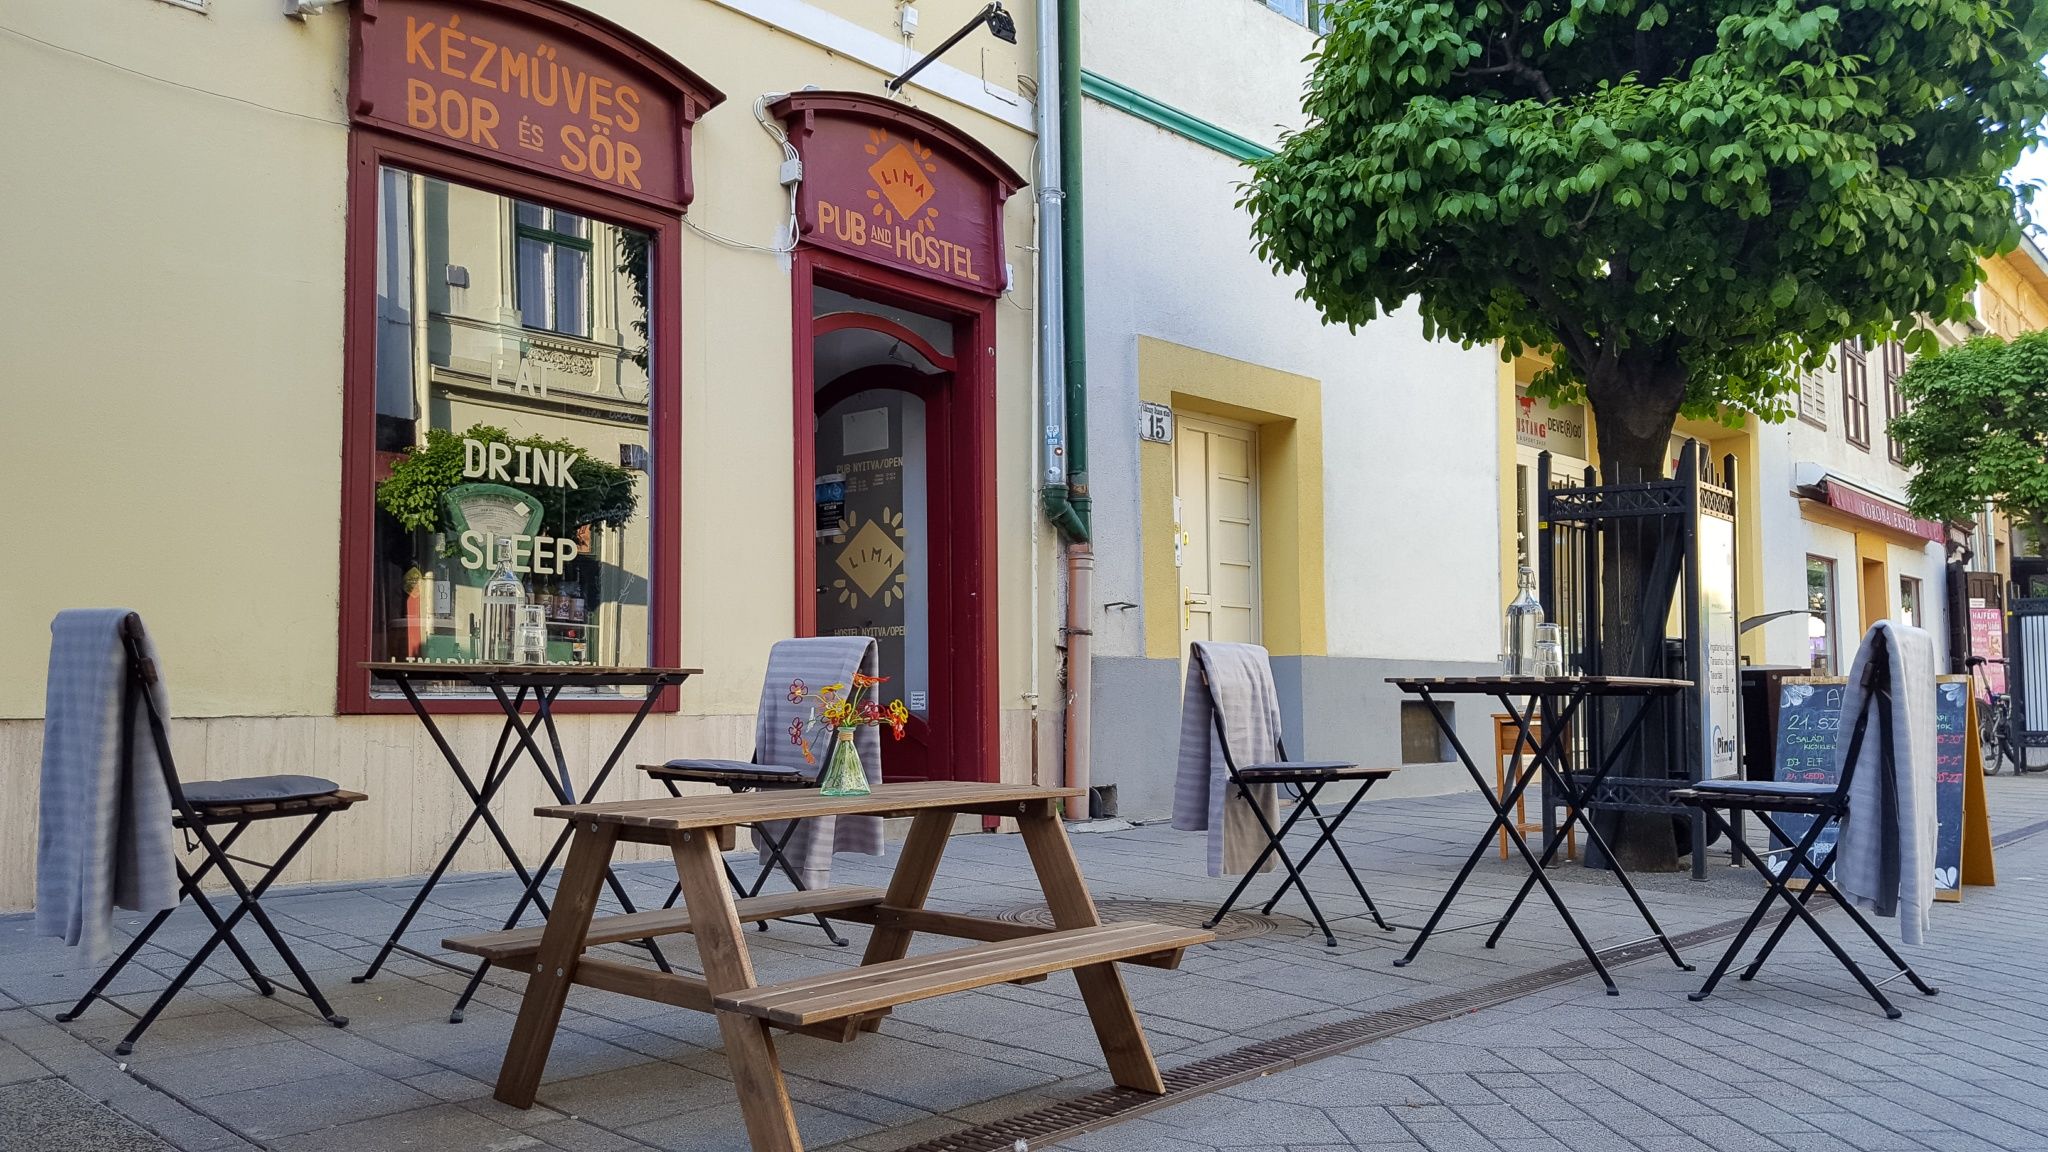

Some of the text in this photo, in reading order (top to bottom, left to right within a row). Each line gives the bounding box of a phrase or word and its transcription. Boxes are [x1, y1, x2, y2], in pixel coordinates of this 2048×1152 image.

[406, 14, 640, 133] KÉZMŰVES
[407, 78, 642, 190] BOR ÉS SÖR
[881, 168, 925, 198] LIMA
[818, 200, 980, 281] PUB AND HOSTEL
[490, 352, 559, 398] EAT
[1149, 414, 1166, 439] 15
[1516, 417, 1546, 438] USTANG
[461, 438, 579, 490] DRINK
[836, 456, 904, 474] PUB NYITVA/OPEN
[1861, 501, 1892, 525] KORONA
[460, 529, 578, 575] SLEEP
[849, 546, 893, 569] LIMA
[1787, 714, 1812, 730] 21.
[1717, 735, 1735, 761] Pingi
